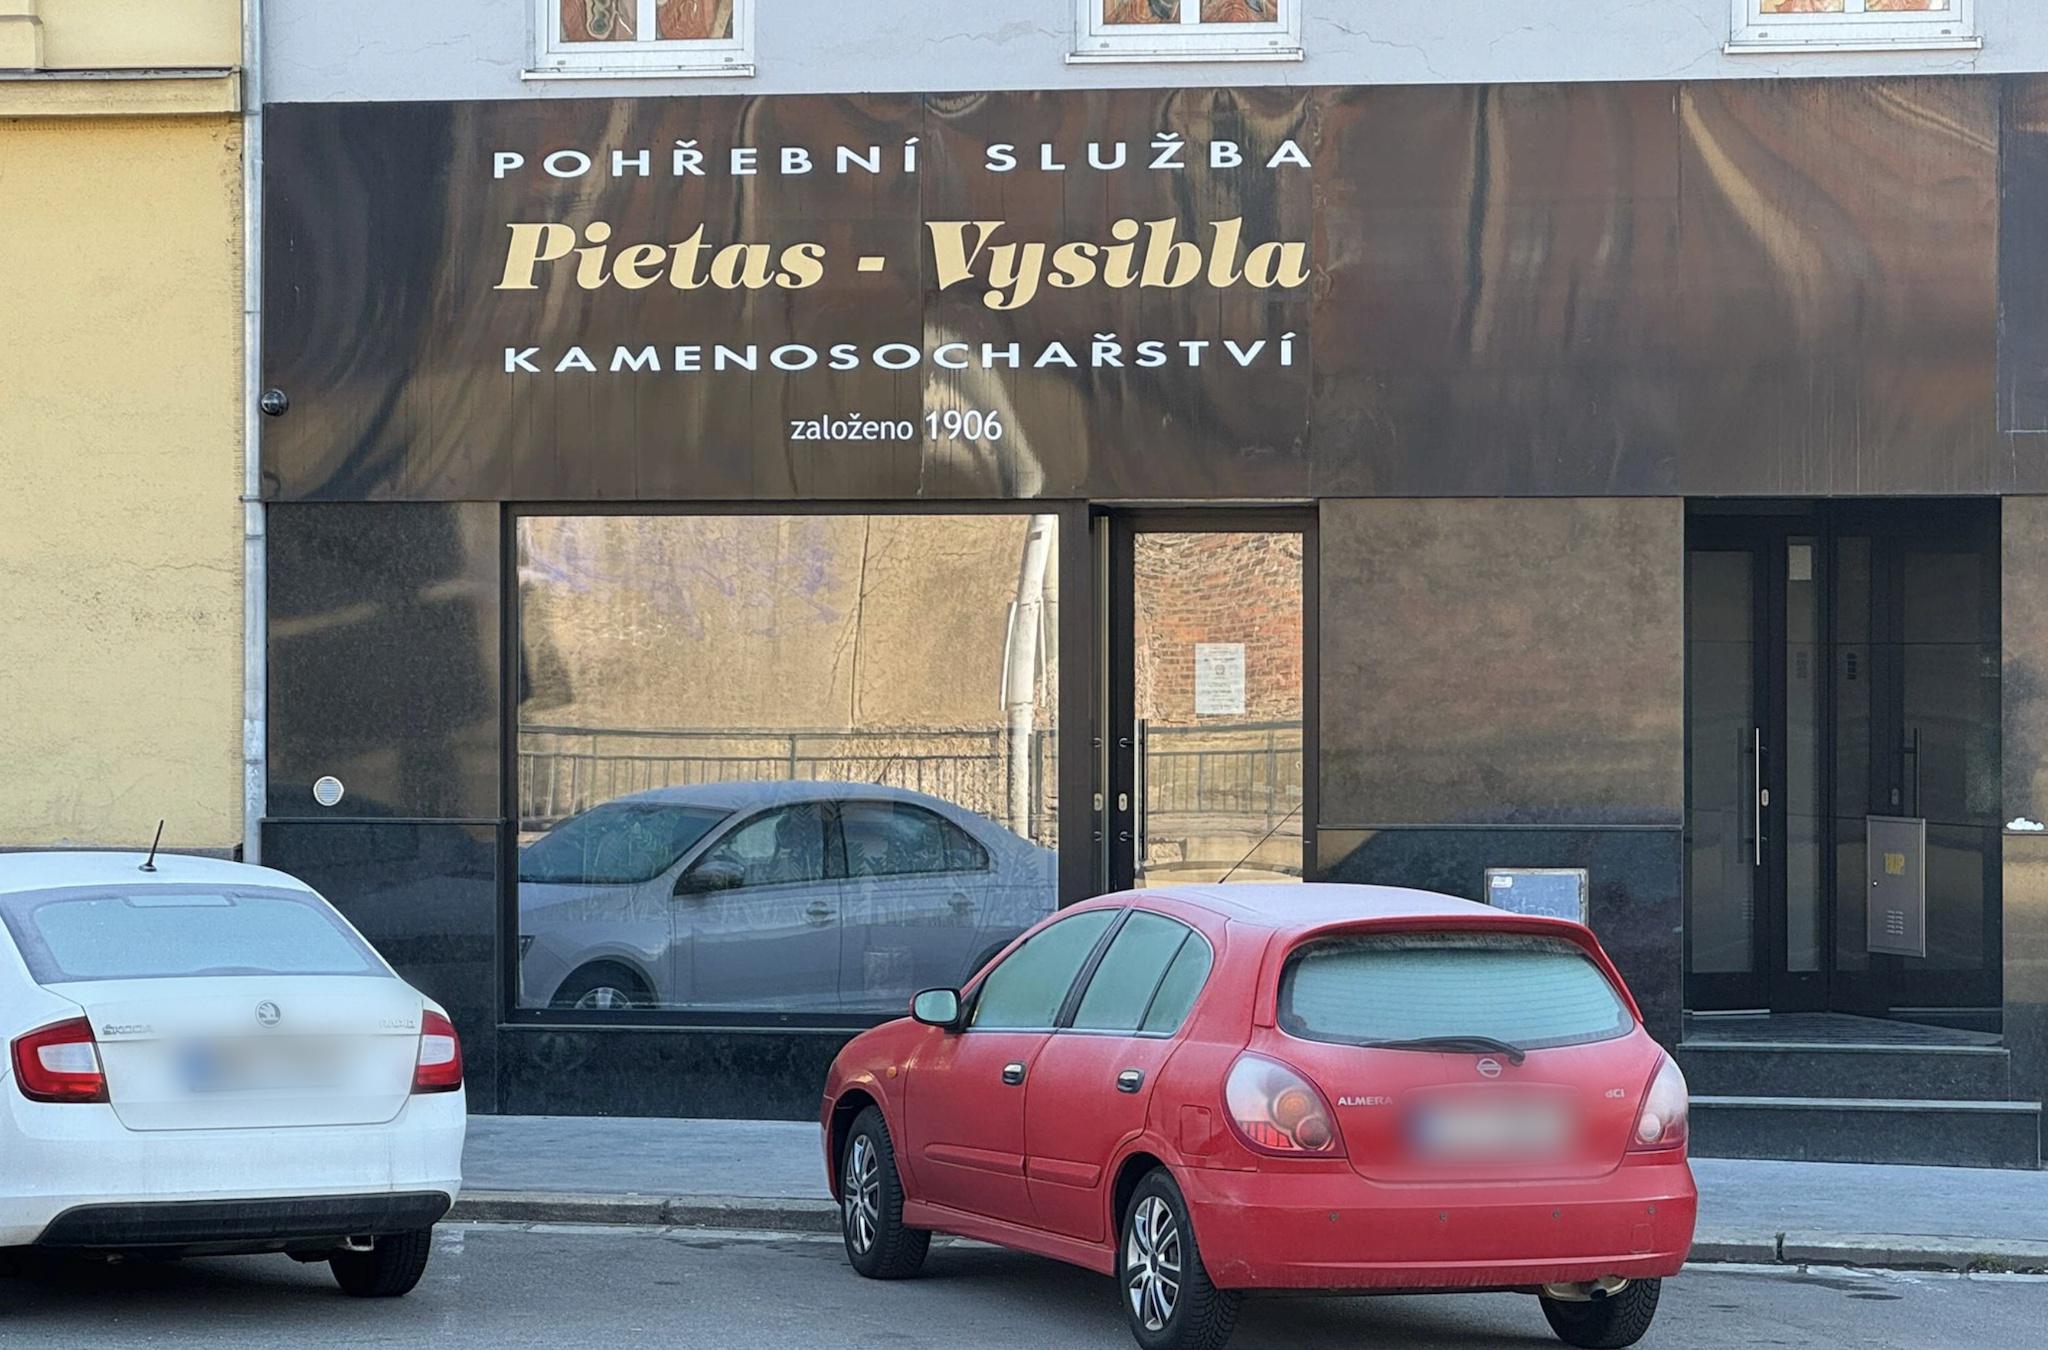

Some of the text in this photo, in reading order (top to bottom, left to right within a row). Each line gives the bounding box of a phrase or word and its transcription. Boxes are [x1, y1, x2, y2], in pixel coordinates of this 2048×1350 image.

[494, 132, 1312, 178] POHŘEBNÍ SLUŽBA
[493, 217, 1311, 310] Pietas - Vysibla
[504, 333, 1297, 373] KAMENOSOCHAŘSTVÍ
[791, 410, 1003, 441] založeno 1906
[1337, 1095, 1394, 1106] ALMERA
